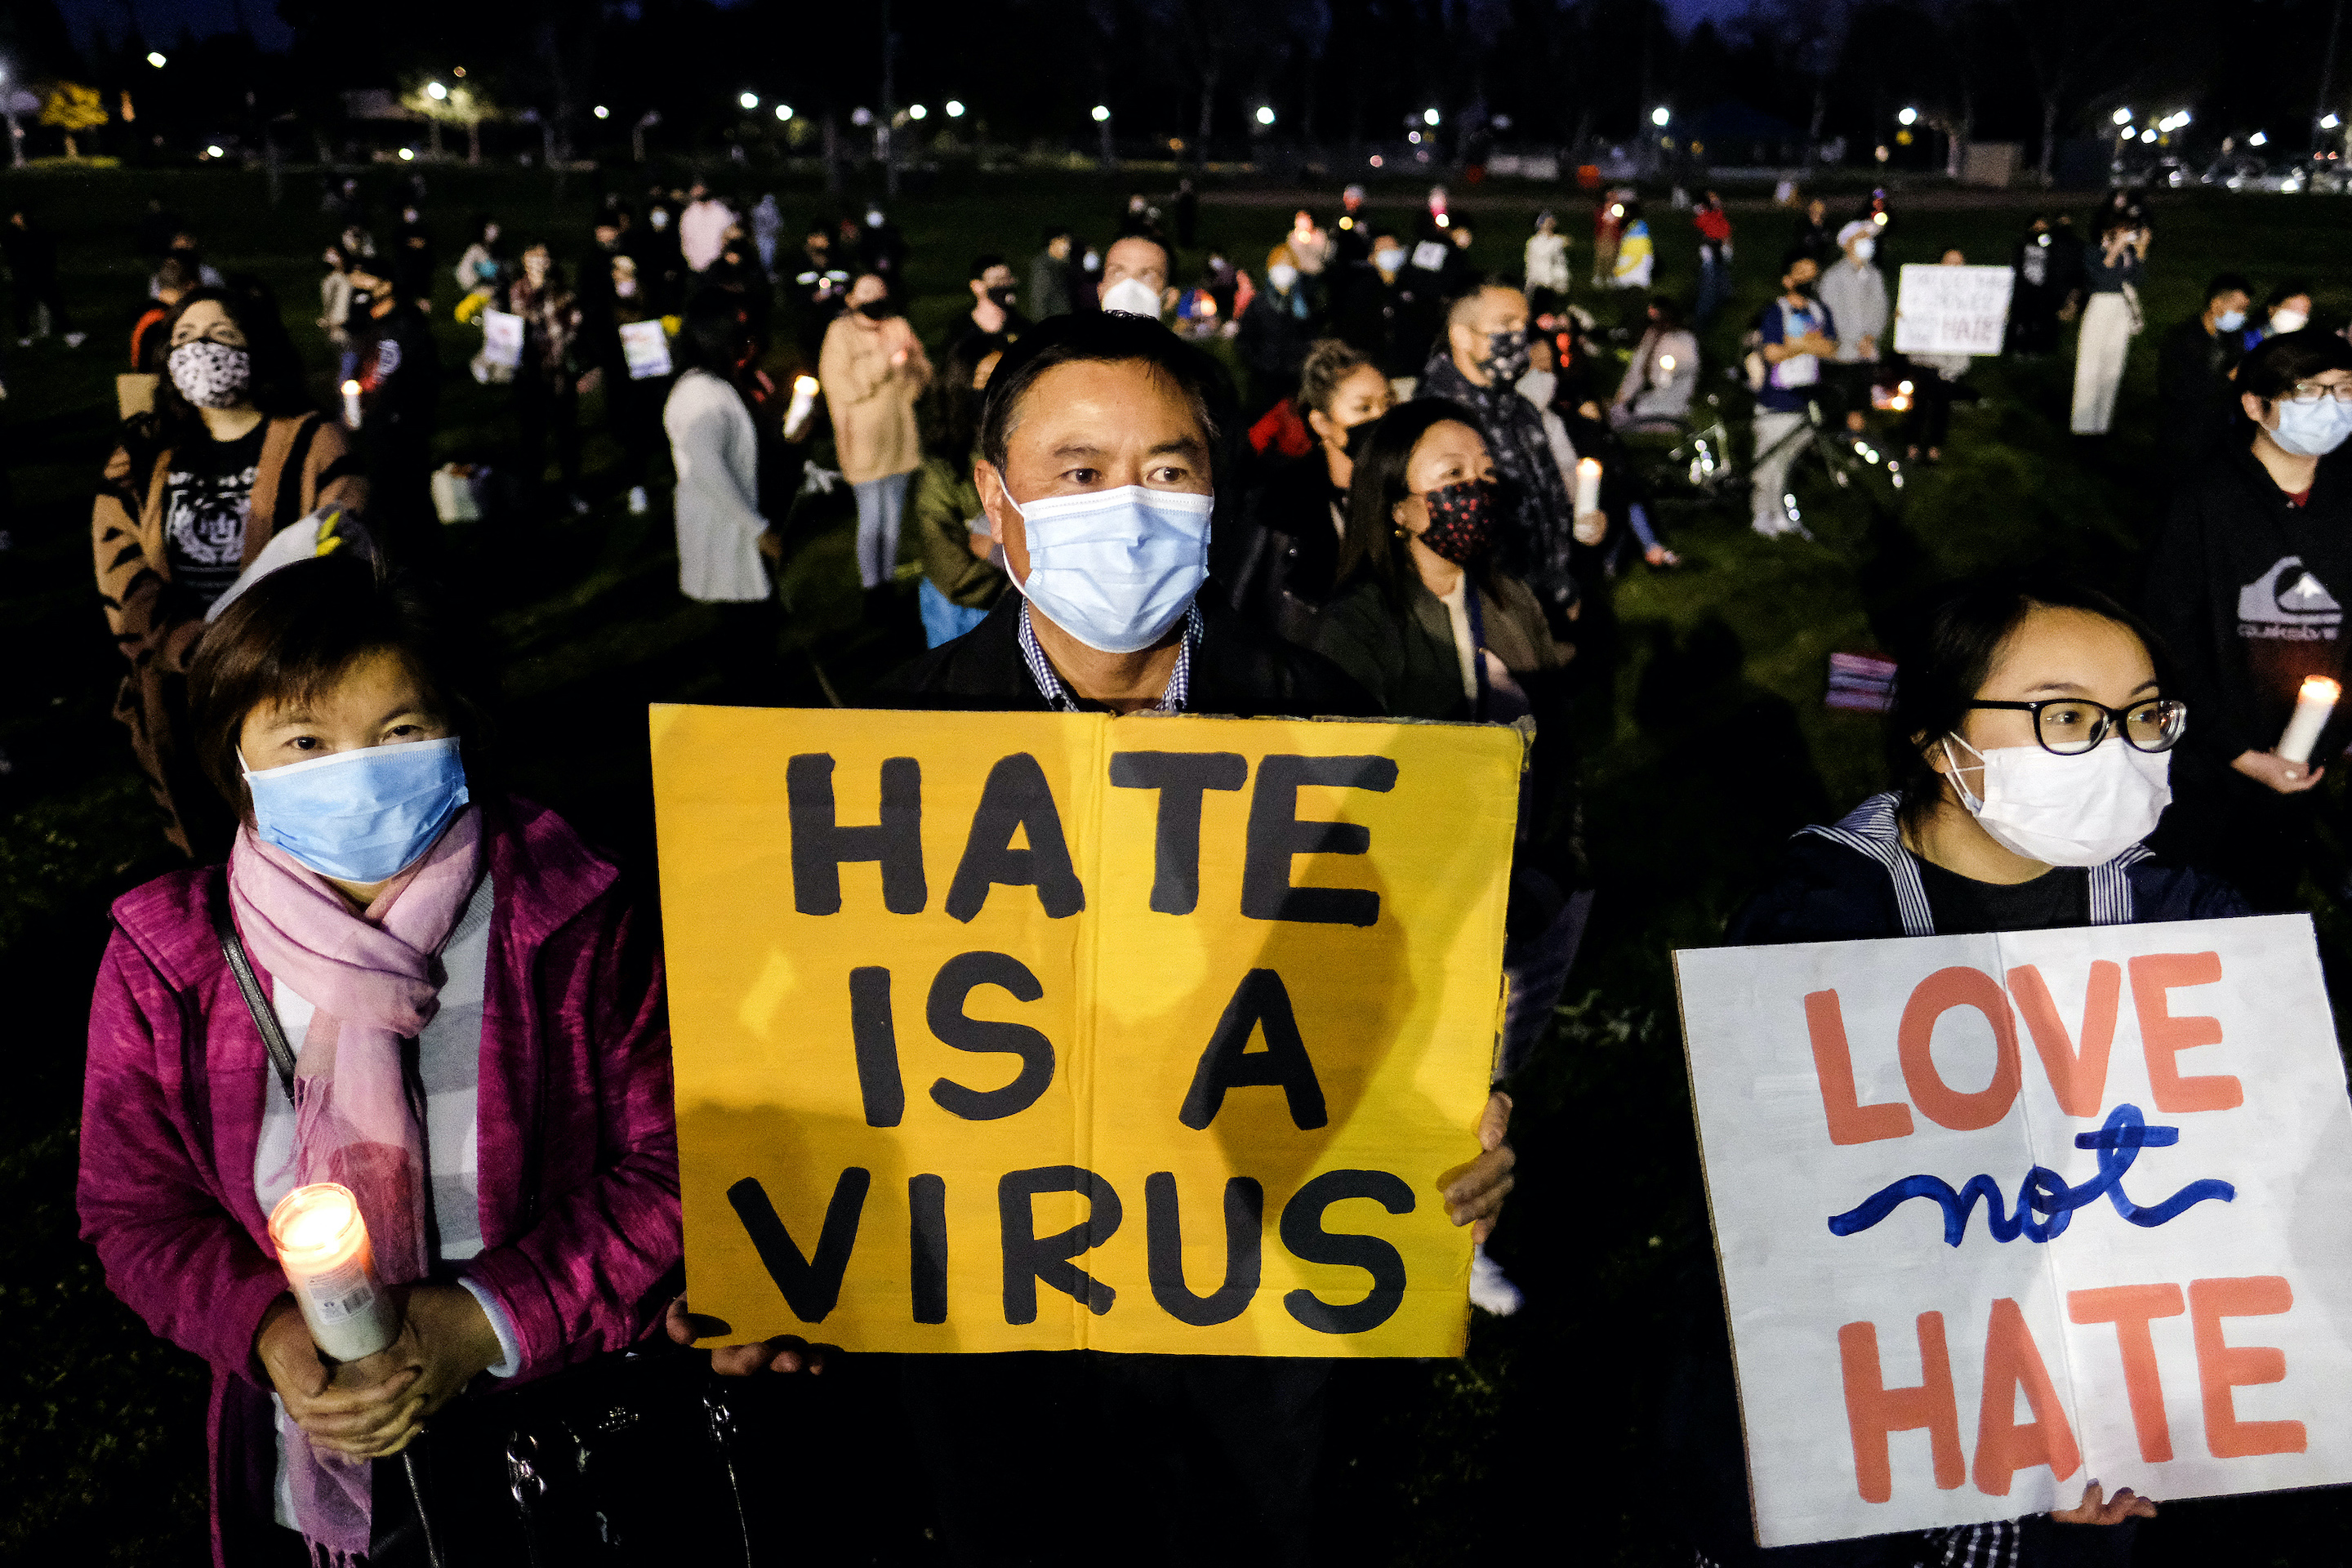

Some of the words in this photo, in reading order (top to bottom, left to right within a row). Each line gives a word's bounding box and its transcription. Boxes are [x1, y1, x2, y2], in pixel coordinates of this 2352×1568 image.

[786, 751, 1400, 929] HATE
[849, 951, 1056, 1129] IS
[1178, 967, 1330, 1132] A
[1803, 951, 2245, 1146] LOVE
[725, 1165, 1416, 1334] VIRUS
[1828, 1103, 2238, 1249] not
[1838, 1276, 2309, 1504] HATE
